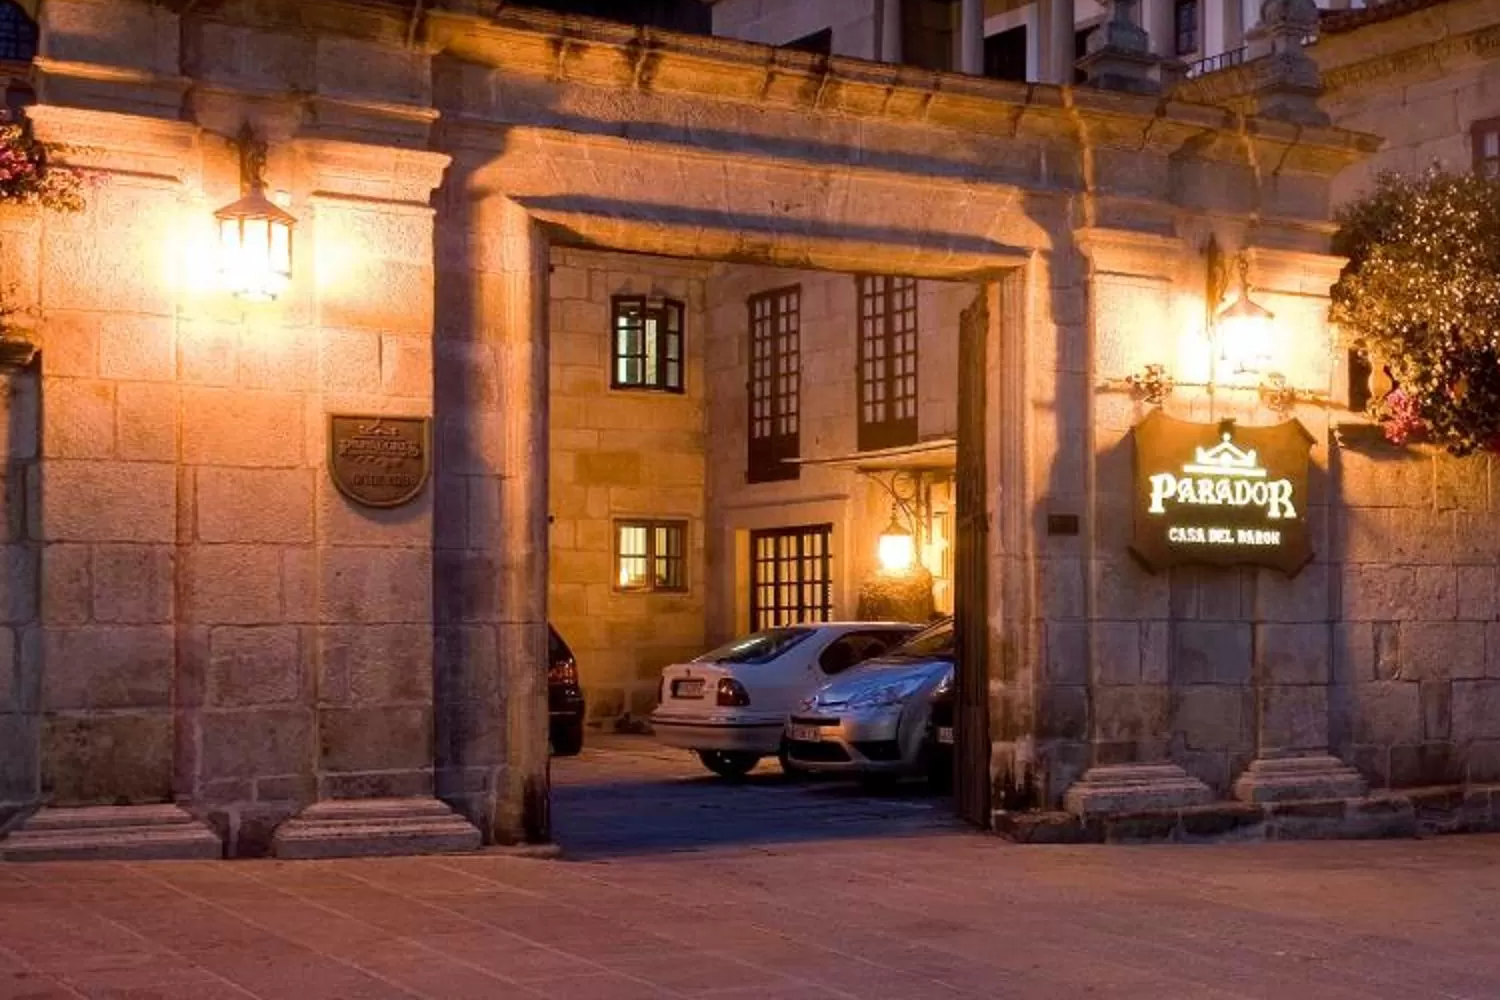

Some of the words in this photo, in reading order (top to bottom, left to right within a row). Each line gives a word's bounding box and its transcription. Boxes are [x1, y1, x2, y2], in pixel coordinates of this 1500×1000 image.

[1148, 472, 1297, 519] PARADOR
[1168, 527, 1206, 543] CASA
[1207, 528, 1235, 543] DEL
